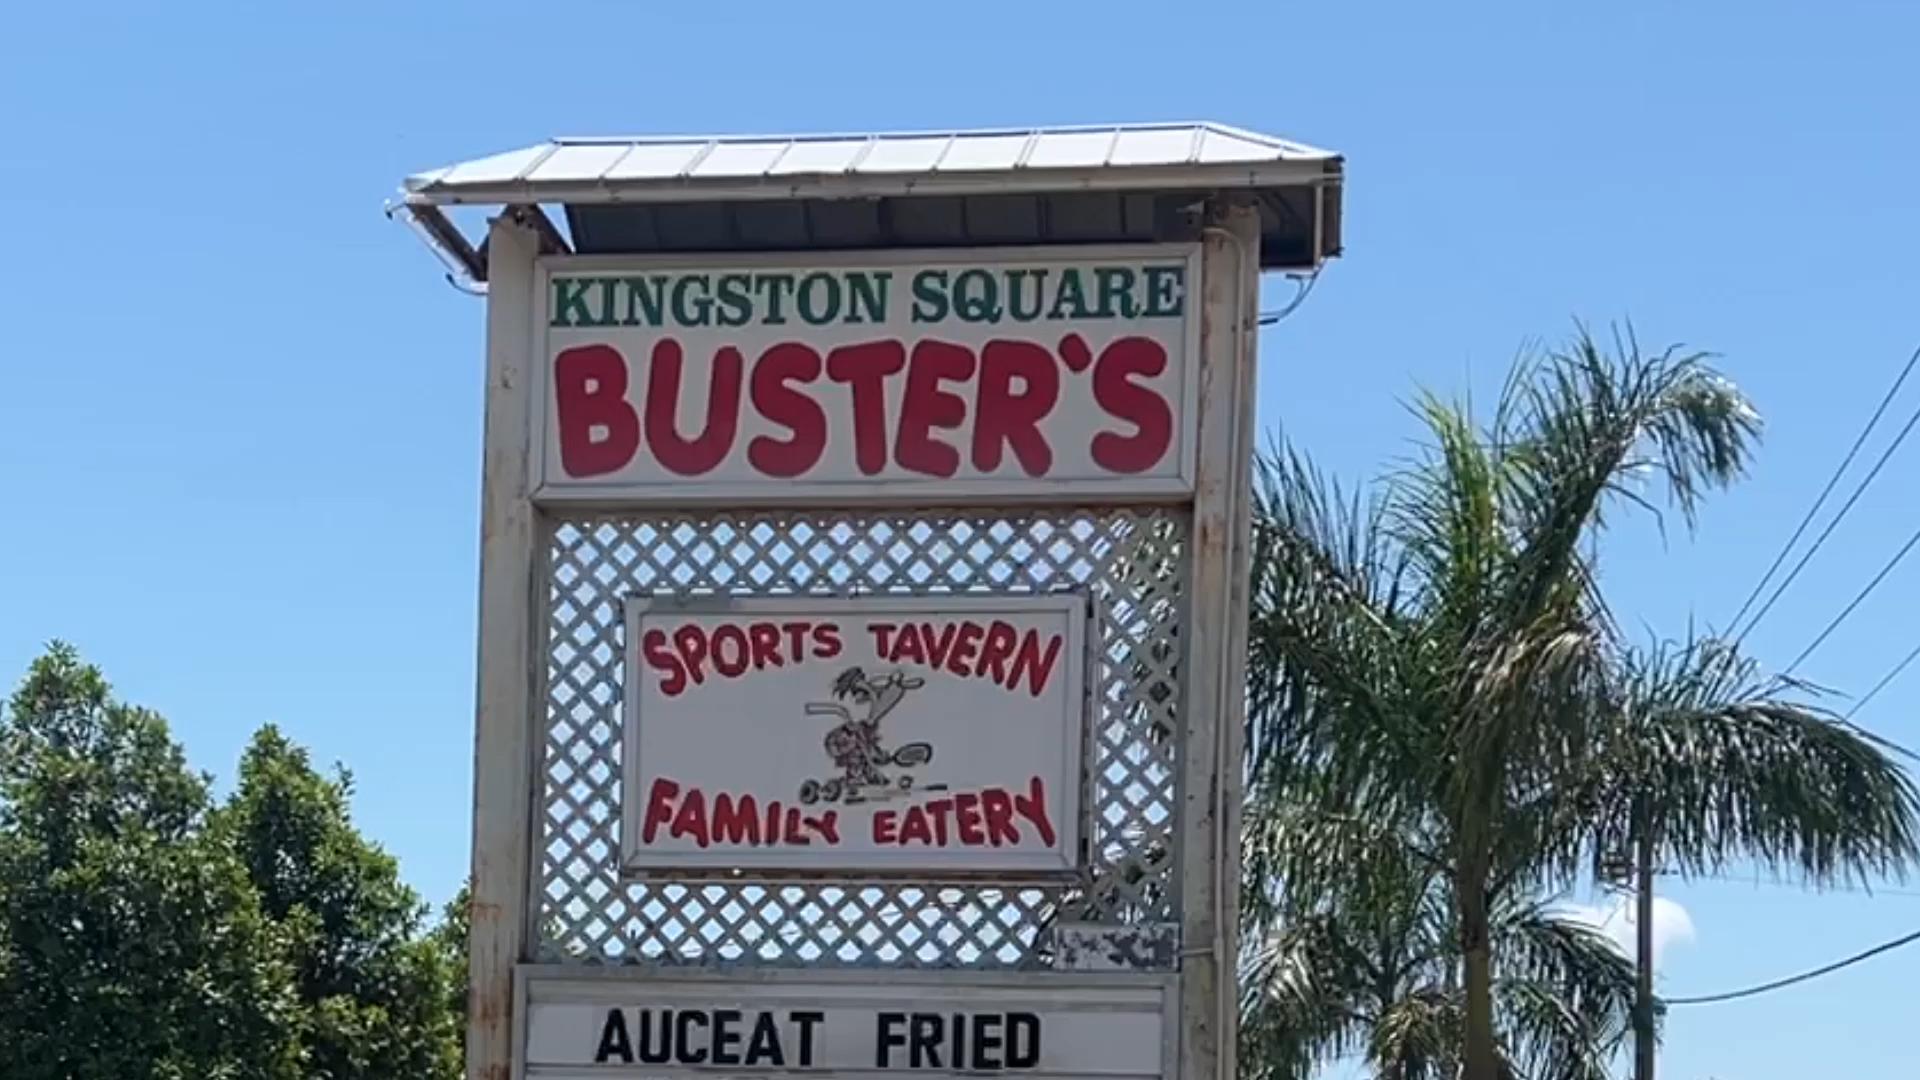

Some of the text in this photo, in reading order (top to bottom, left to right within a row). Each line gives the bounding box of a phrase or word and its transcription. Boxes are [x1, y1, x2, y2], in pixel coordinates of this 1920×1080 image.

[549, 266, 1185, 328] KINGSTON SQUARE
[554, 332, 1174, 478] BUSTER'S
[642, 620, 1063, 697] SPORTS TAVERN
[642, 776, 1057, 848] FAMILY EATERY
[595, 1007, 1041, 1069] AUCEAT FRIED
